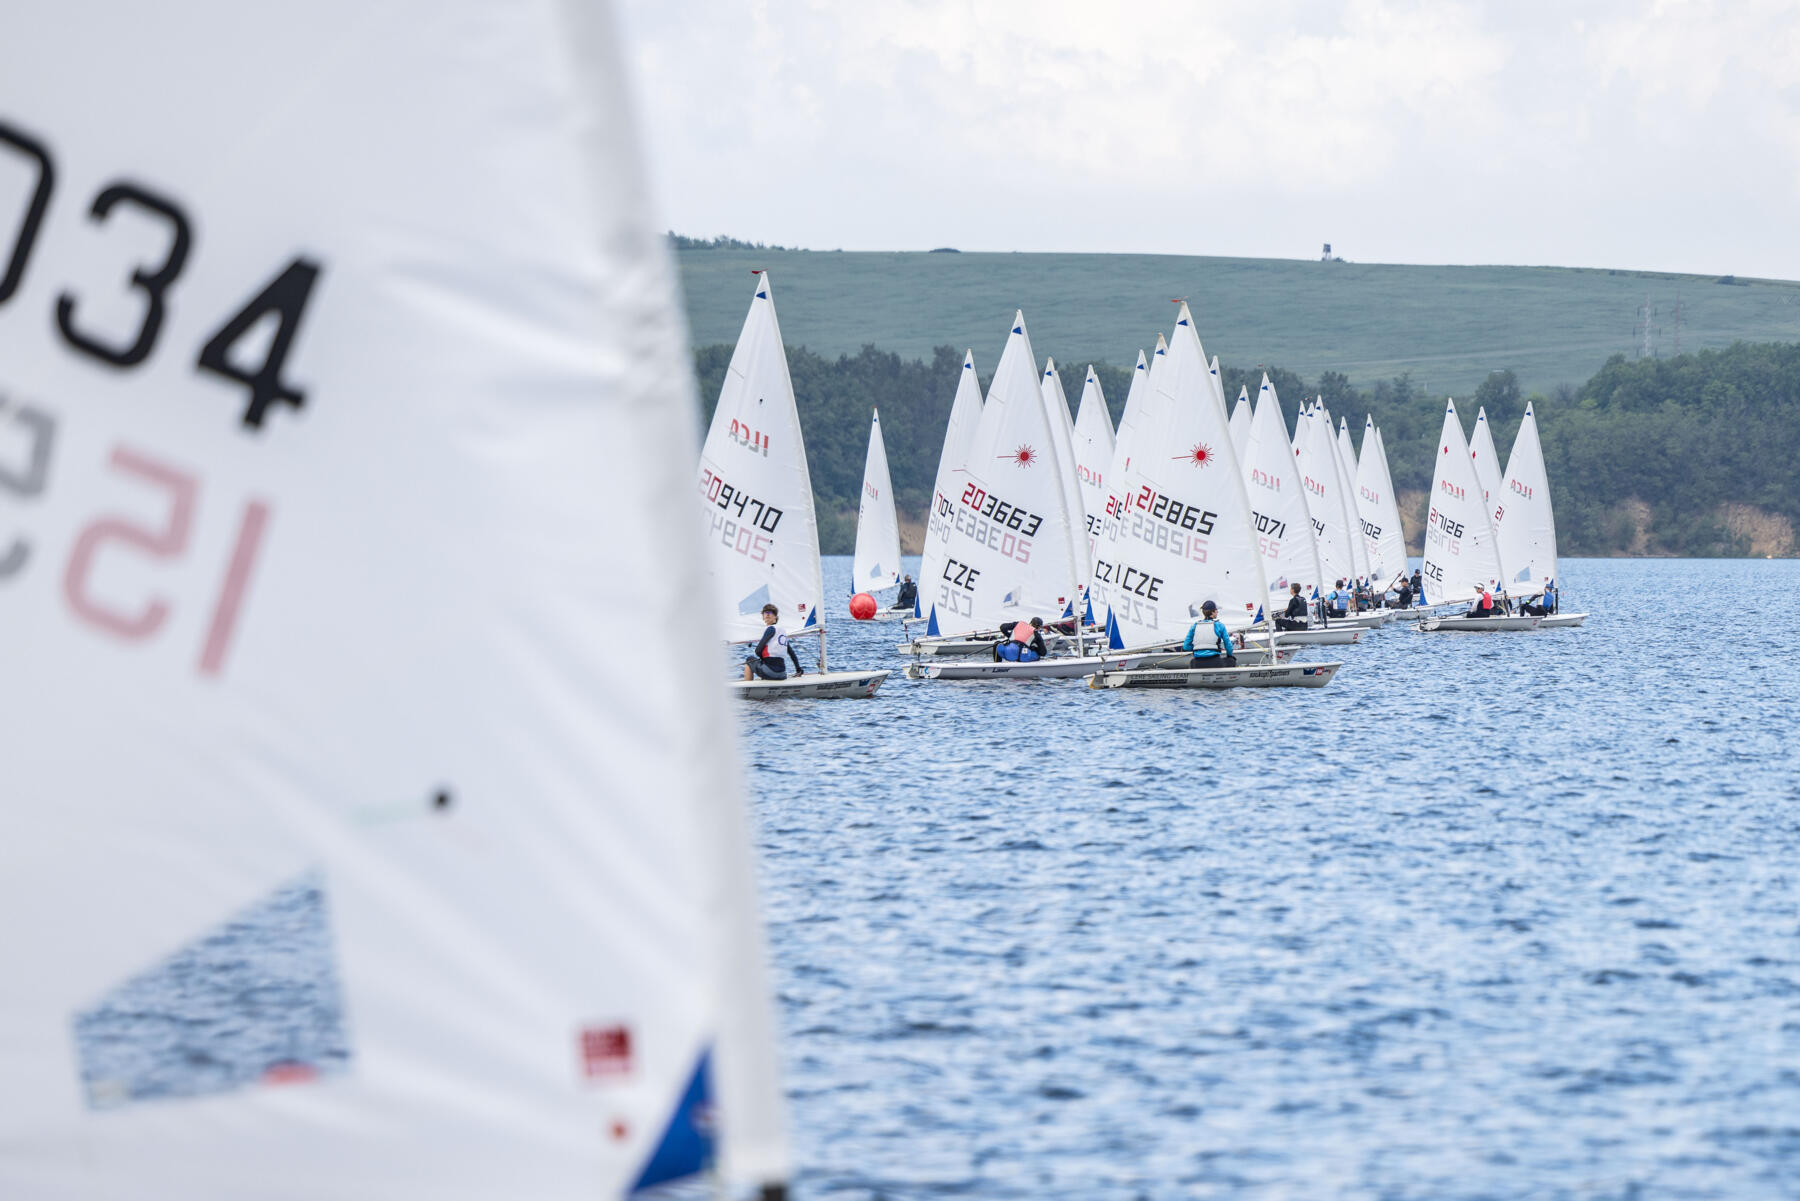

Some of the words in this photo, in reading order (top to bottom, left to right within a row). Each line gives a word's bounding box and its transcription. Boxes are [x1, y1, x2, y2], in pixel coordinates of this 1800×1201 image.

[698, 468, 784, 534] 209470
[961, 482, 1044, 537] 203663
[1135, 485, 1218, 536] 212865
[1430, 506, 1465, 539] 217126
[943, 558, 981, 592] CZE
[1122, 566, 1164, 602] CZE
[1424, 560, 1444, 582] CZE
